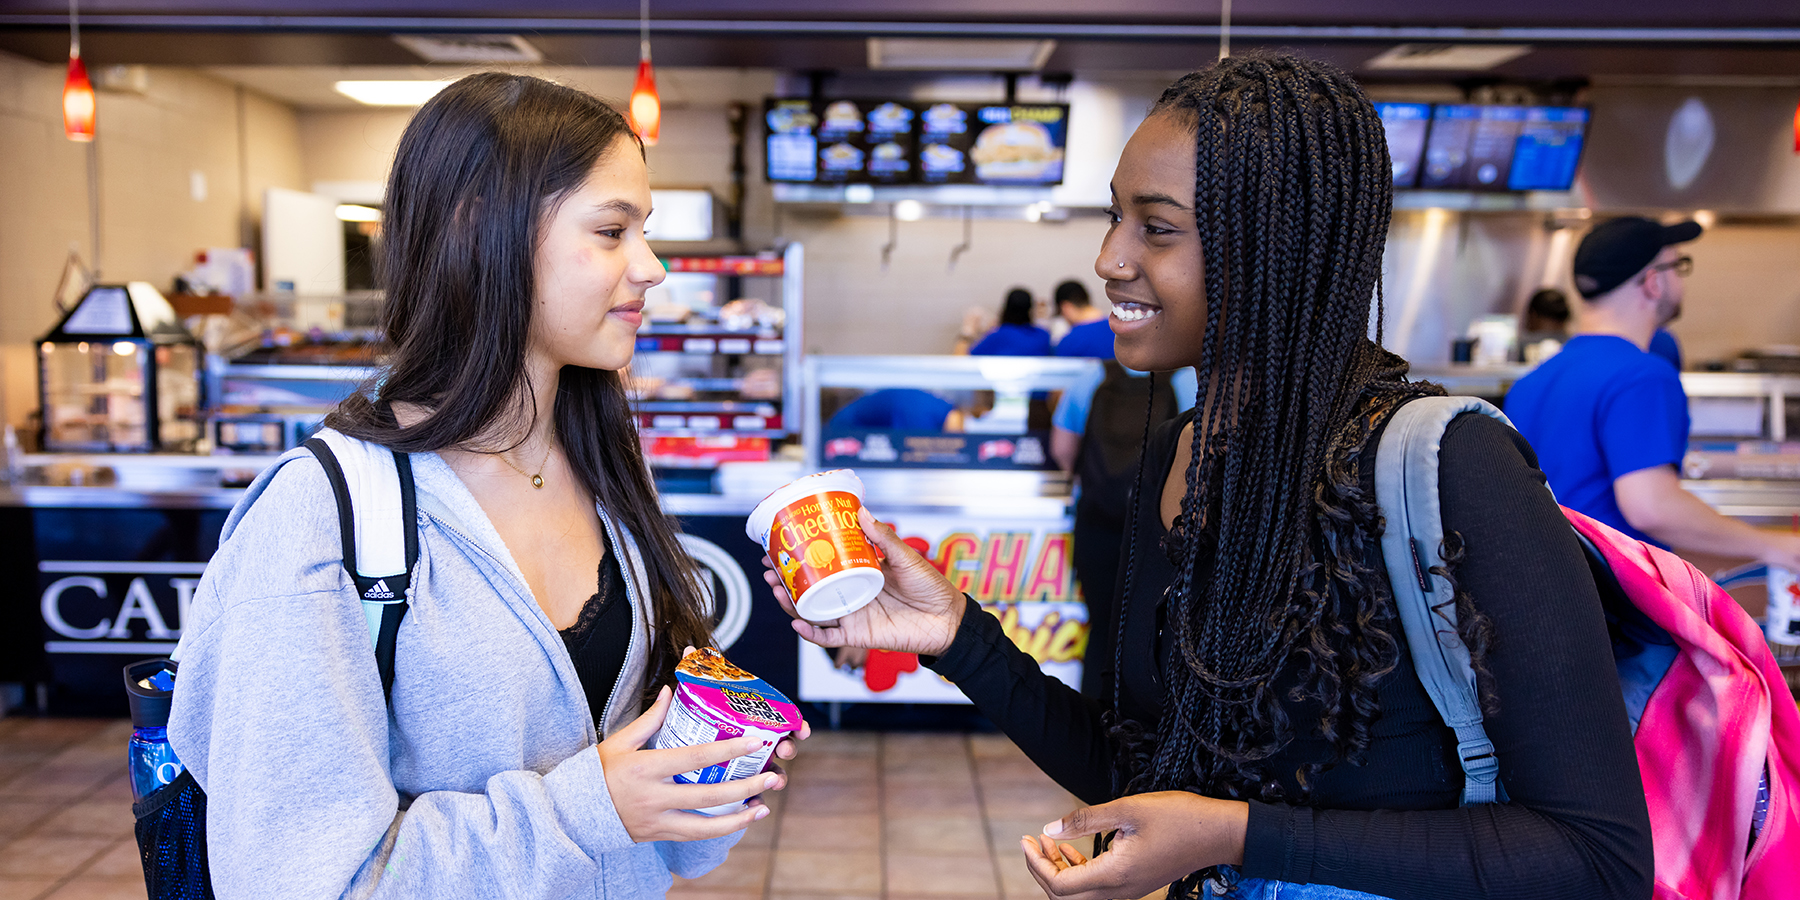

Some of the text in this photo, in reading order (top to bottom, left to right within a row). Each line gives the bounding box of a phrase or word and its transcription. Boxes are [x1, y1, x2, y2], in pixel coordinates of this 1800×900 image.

[800, 500, 834, 516] Honey
[835, 497, 853, 508] Nut
[780, 510, 862, 551] Cheerios
[937, 533, 1085, 602] CHA
[364, 591, 395, 599] adidas
[720, 686, 765, 702] Crunch
[724, 694, 773, 713] Bran
[725, 701, 790, 724] Raisin
[718, 722, 740, 735] GO!
